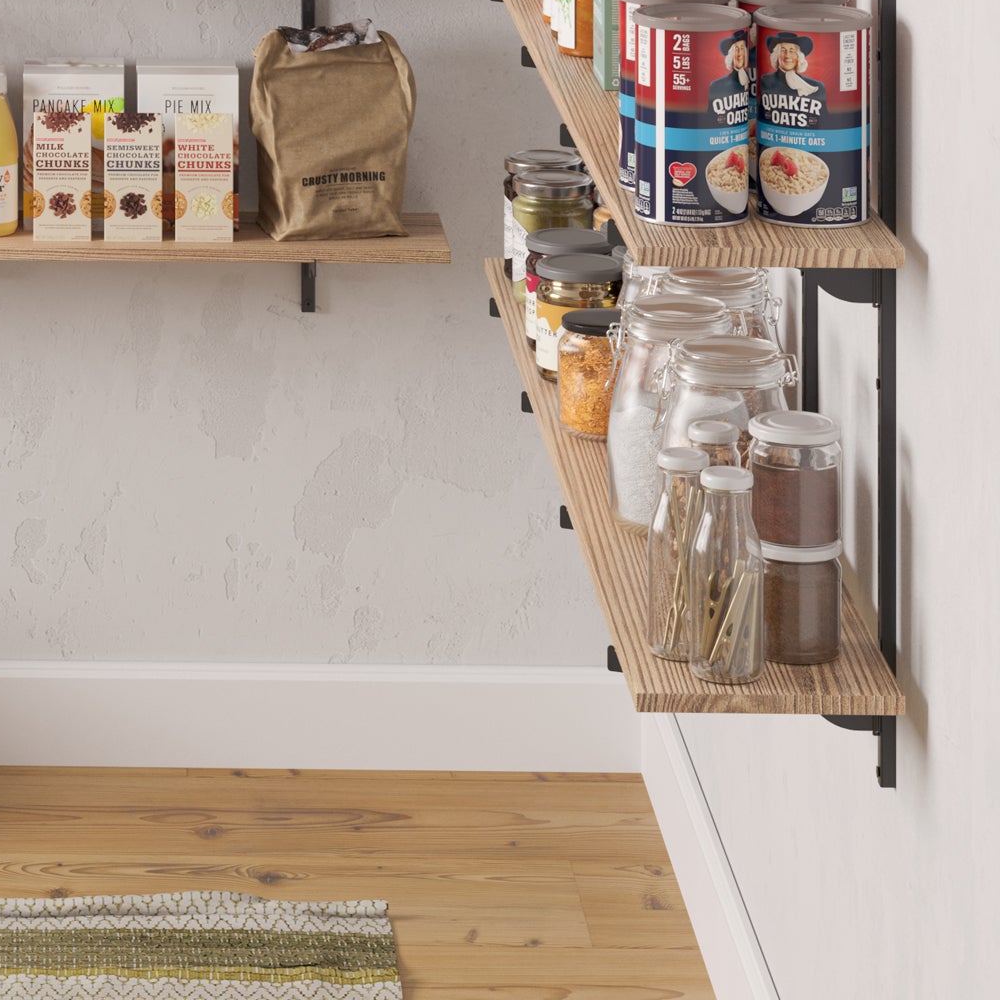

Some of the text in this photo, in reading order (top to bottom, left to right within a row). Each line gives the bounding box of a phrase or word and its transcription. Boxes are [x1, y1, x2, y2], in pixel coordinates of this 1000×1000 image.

[673, 34, 690, 52] 2 BAGS
[673, 56, 690, 70] 5 LBS
[673, 73, 690, 85] 55+
[33, 98, 115, 113] PANCAKE MIX
[165, 99, 212, 113] PIE MIX
[762, 94, 822, 115] QUAKER
[771, 111, 808, 127] OATS
[709, 137, 729, 145] QUICK
[776, 134, 826, 146] 1-MINUTE OATS
[36, 159, 89, 168] CHUNKS
[107, 160, 160, 168] CHUNKS
[178, 160, 231, 169] CHUNKS
[302, 171, 386, 187] CRUSTY MORNING
